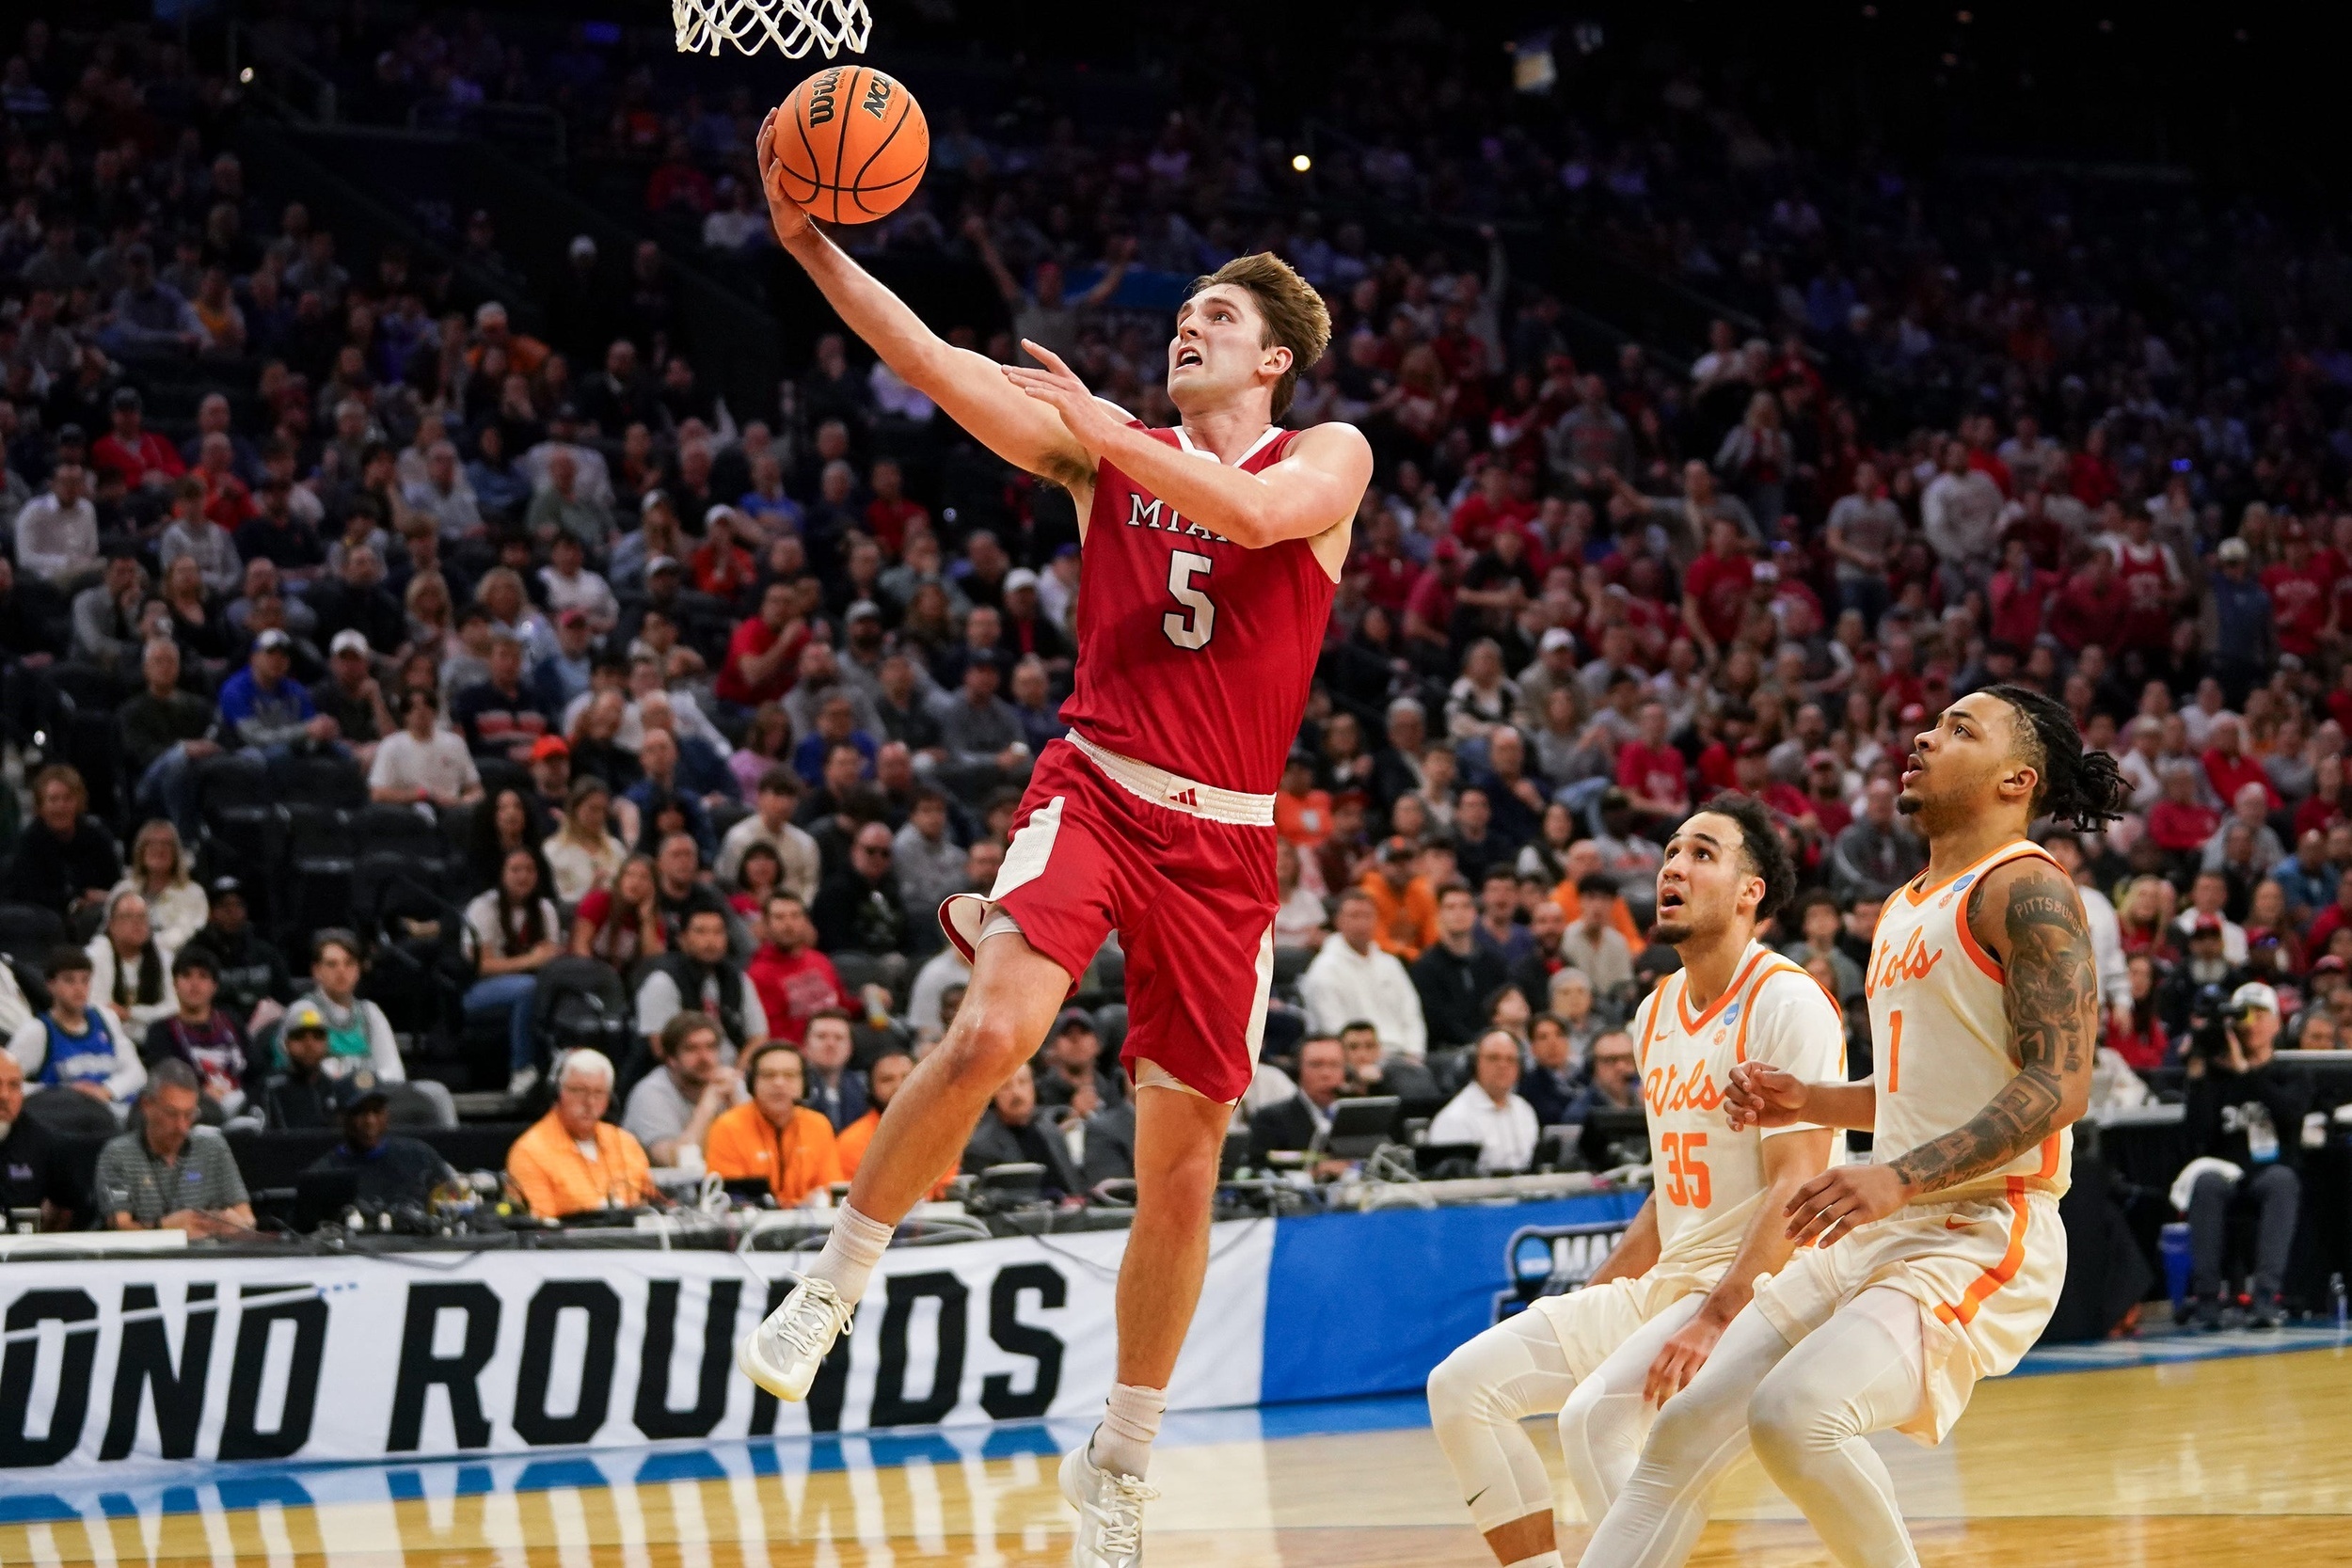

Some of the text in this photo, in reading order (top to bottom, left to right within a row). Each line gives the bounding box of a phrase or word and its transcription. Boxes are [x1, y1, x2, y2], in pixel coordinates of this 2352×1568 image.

[810, 67, 844, 128] Wils
[862, 71, 893, 119] NCA
[1127, 493, 1229, 542] MIA
[1164, 550, 1216, 650] 5
[2014, 896, 2084, 937] PITTSBURGH
[1866, 925, 1943, 1000] Vols
[1888, 1009, 1903, 1094] 1
[1645, 1059, 1727, 1117] Vols
[1661, 1132, 1712, 1210] 35
[1553, 1231, 1625, 1272] MA
